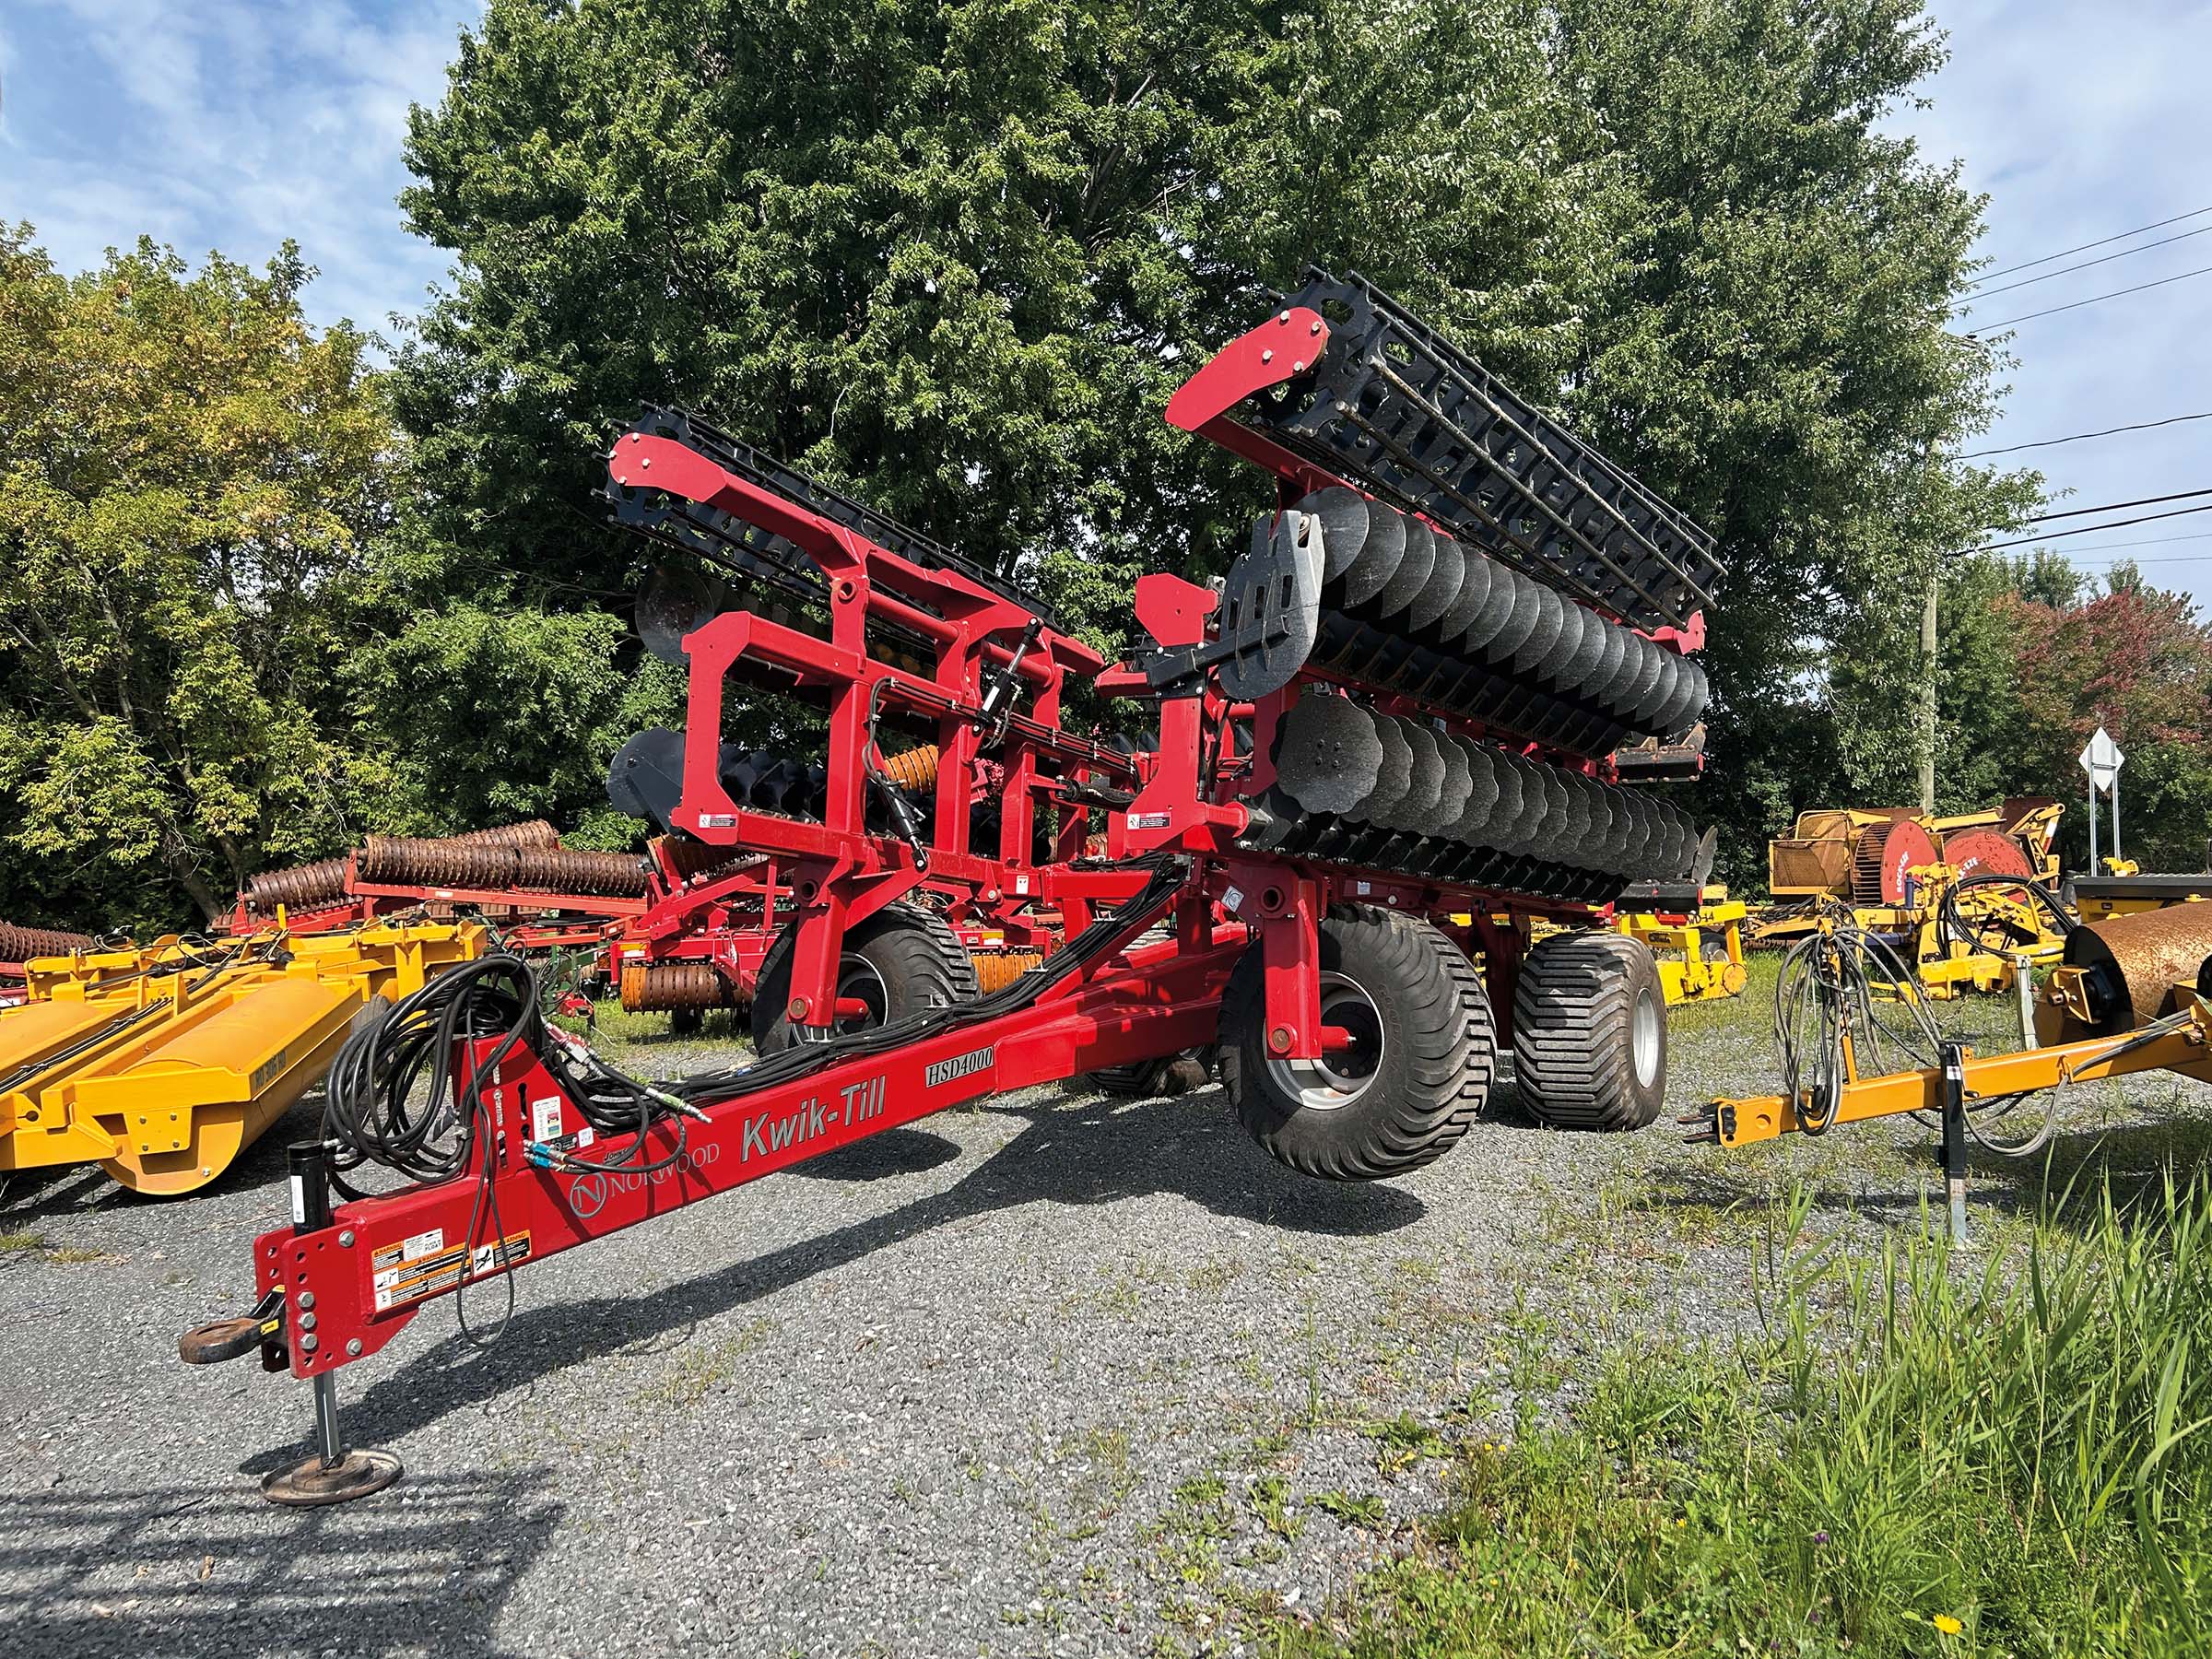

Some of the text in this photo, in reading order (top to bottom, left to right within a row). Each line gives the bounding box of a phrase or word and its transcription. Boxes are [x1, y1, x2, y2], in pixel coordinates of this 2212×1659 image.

[927, 1047, 993, 1087] HSD4000
[740, 1075, 886, 1164] Kwik-Till
[610, 1143, 721, 1197] NORWOOD
[424, 1241, 441, 1252] FLOAT
